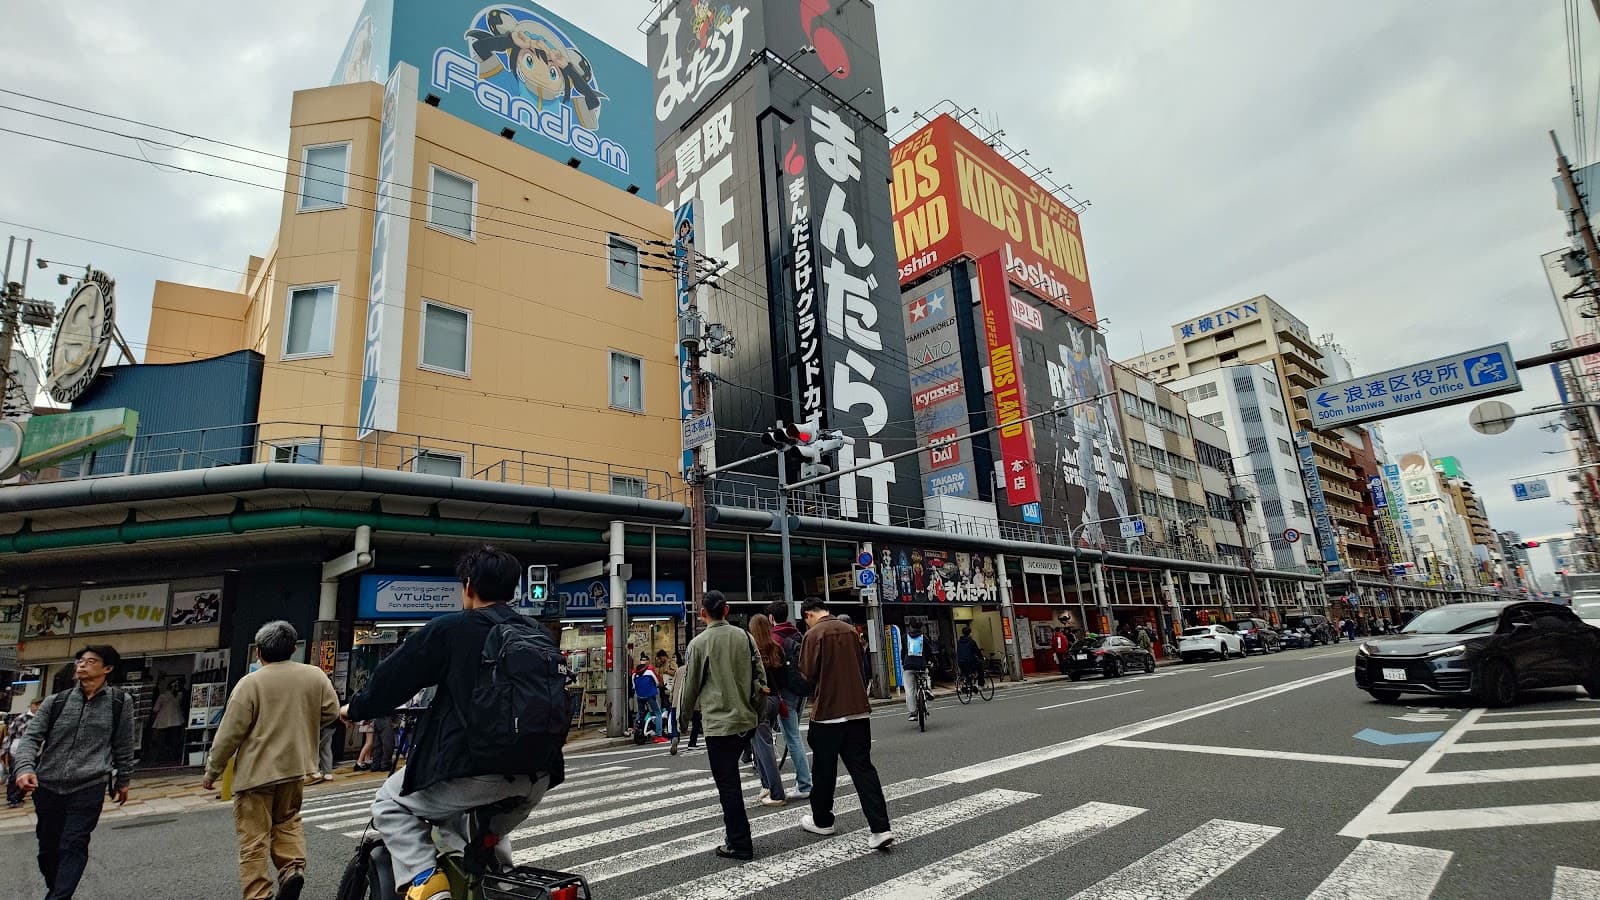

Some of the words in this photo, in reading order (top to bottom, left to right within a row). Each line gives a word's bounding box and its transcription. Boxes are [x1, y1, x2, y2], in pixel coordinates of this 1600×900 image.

[432, 47, 629, 173] Fandom
[675, 101, 735, 188] 買取
[890, 127, 934, 164] UPER
[893, 195, 950, 263] AND
[955, 150, 1023, 244] KIDS
[1024, 200, 1087, 284] LAND
[1028, 184, 1078, 233] SUPER
[898, 250, 938, 281] oshin
[1004, 241, 1071, 307] Joshin
[788, 176, 823, 429] まんだらけグランドカオ
[810, 104, 897, 527] まんだらけ
[906, 329, 930, 344] TAMIYA
[930, 318, 956, 334] WORLD
[986, 309, 998, 347] SUPER
[914, 340, 952, 367] KATO
[991, 344, 1016, 388] KIDS
[1318, 406, 1344, 420] 500m
[1347, 398, 1385, 414] Naniwa
[1392, 390, 1422, 404] Ward
[1429, 382, 1464, 397] Office
[1344, 362, 1459, 404] 浪速区役所
[997, 388, 1023, 438] LAND
[931, 472, 965, 488] TAKARA
[932, 481, 965, 497] TOMY
[1010, 459, 1027, 490] 本店
[394, 592, 449, 602] VTuber
